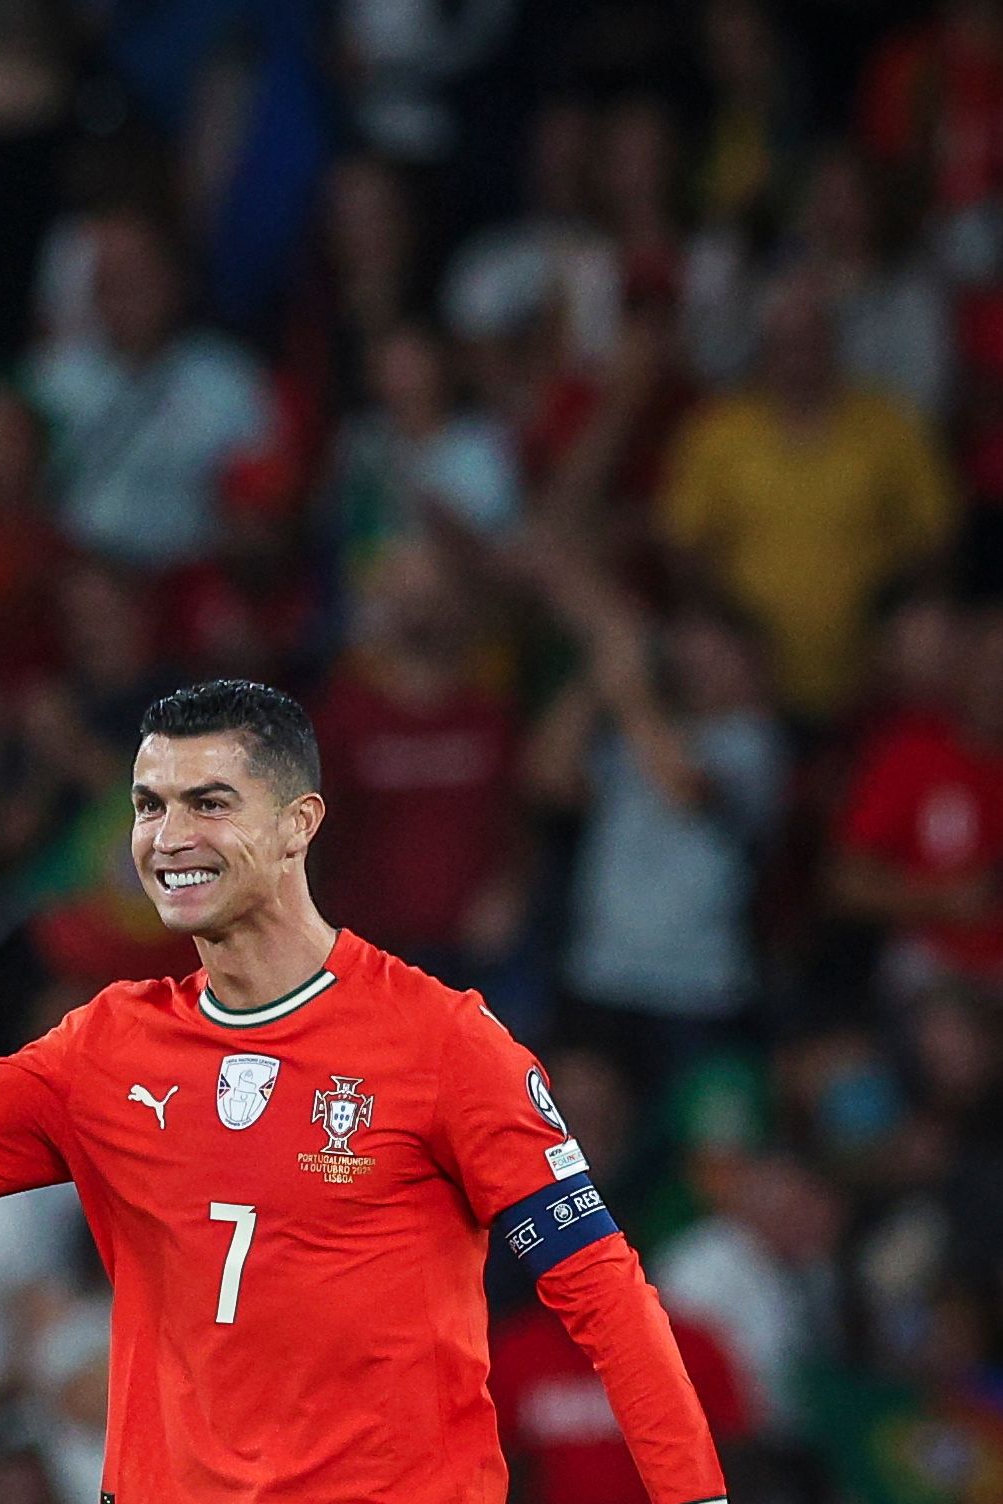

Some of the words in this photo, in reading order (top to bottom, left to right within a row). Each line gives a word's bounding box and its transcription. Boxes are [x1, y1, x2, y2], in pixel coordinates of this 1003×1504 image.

[310, 1164, 351, 1175] OUTUBRO
[324, 1173, 354, 1184] LISBOA
[210, 1201, 257, 1324] 7
